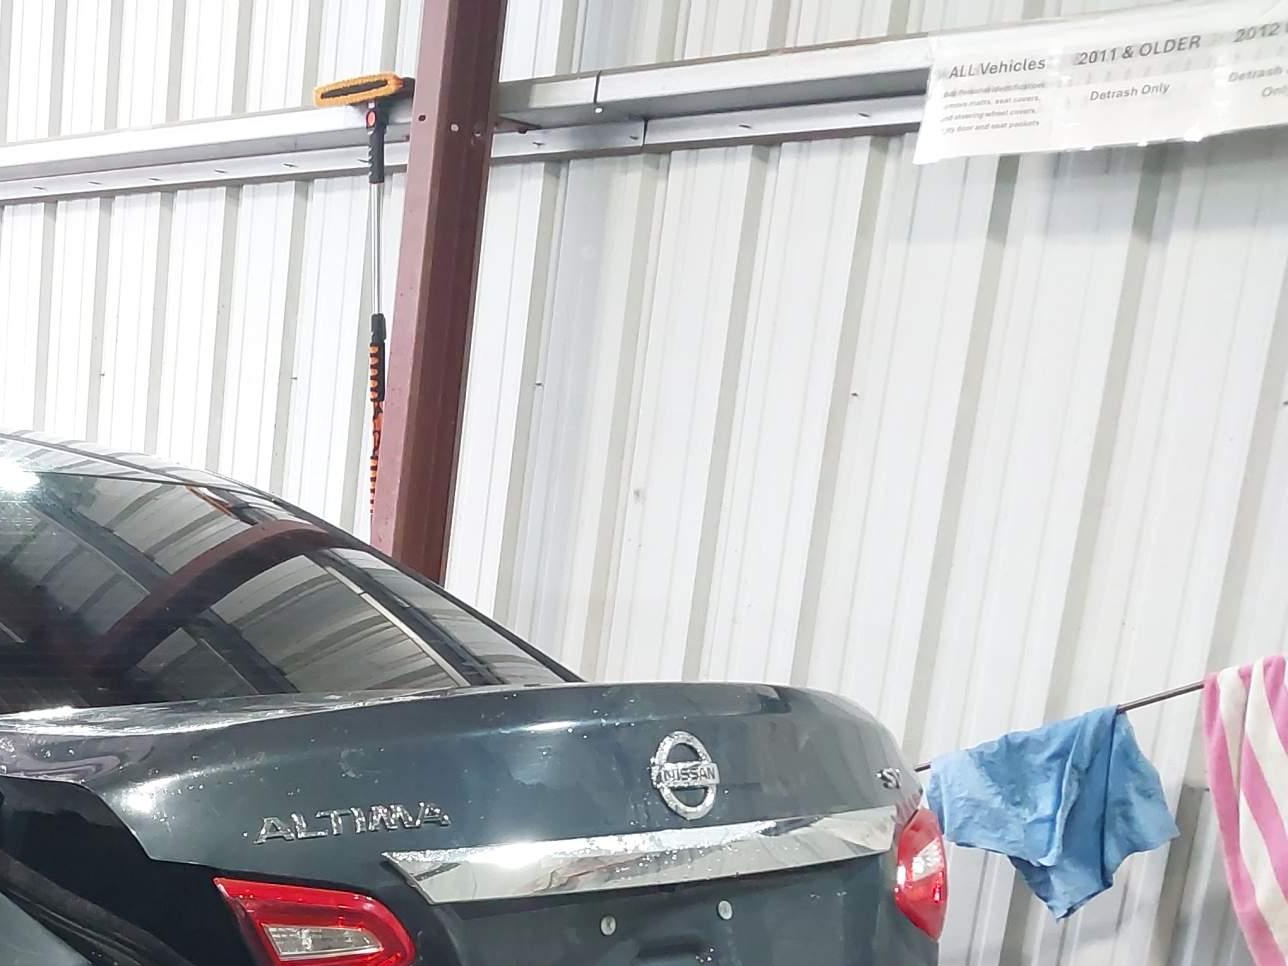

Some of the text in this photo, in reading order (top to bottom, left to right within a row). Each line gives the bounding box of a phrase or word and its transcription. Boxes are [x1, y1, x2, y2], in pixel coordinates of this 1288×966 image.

[1077, 35, 1201, 65] 2011 & OLDER
[949, 58, 1046, 79] ALL Vehicles
[1090, 82, 1170, 101] Detrash Only
[664, 767, 716, 781] NISSAN
[253, 802, 451, 845] ALTIMA
